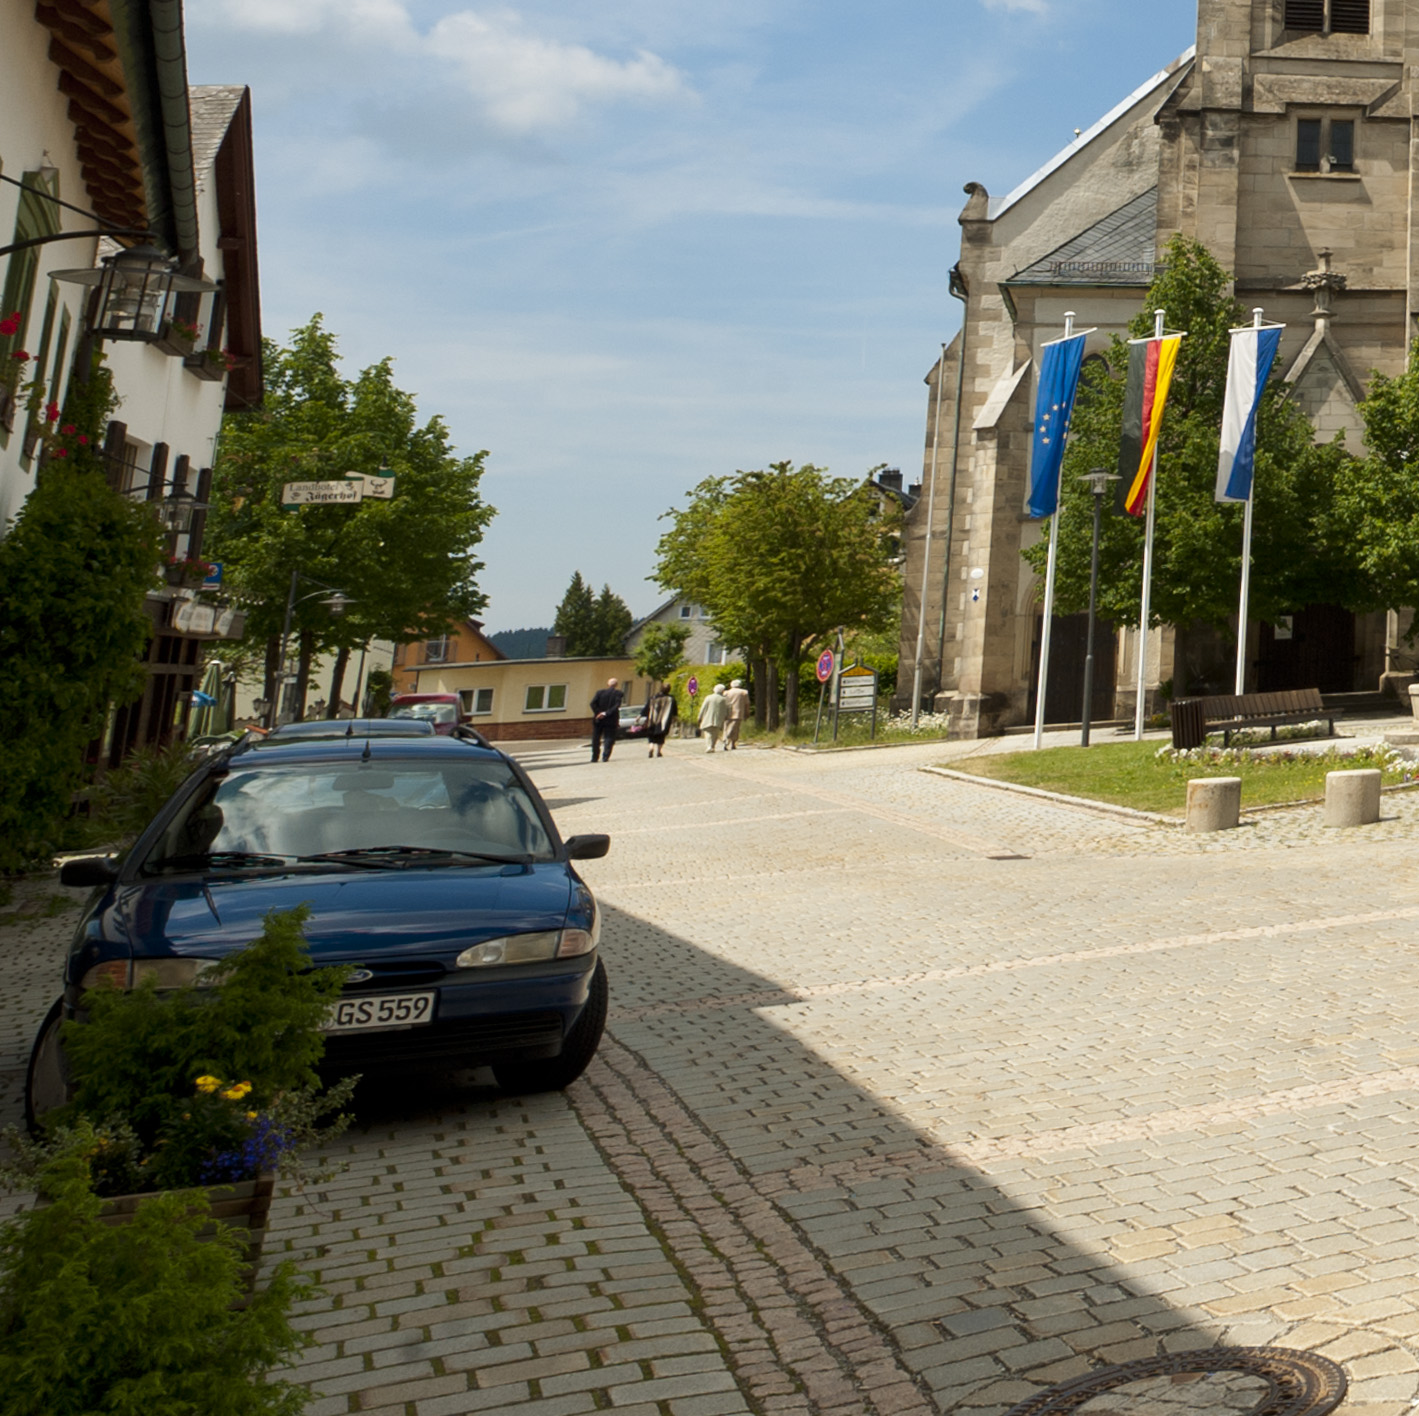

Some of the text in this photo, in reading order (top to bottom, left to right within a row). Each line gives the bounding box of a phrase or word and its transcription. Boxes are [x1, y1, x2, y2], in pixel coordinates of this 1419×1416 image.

[289, 481, 339, 492] Landhotel
[305, 490, 357, 502] Jägerhof
[337, 996, 430, 1026] GS 559
